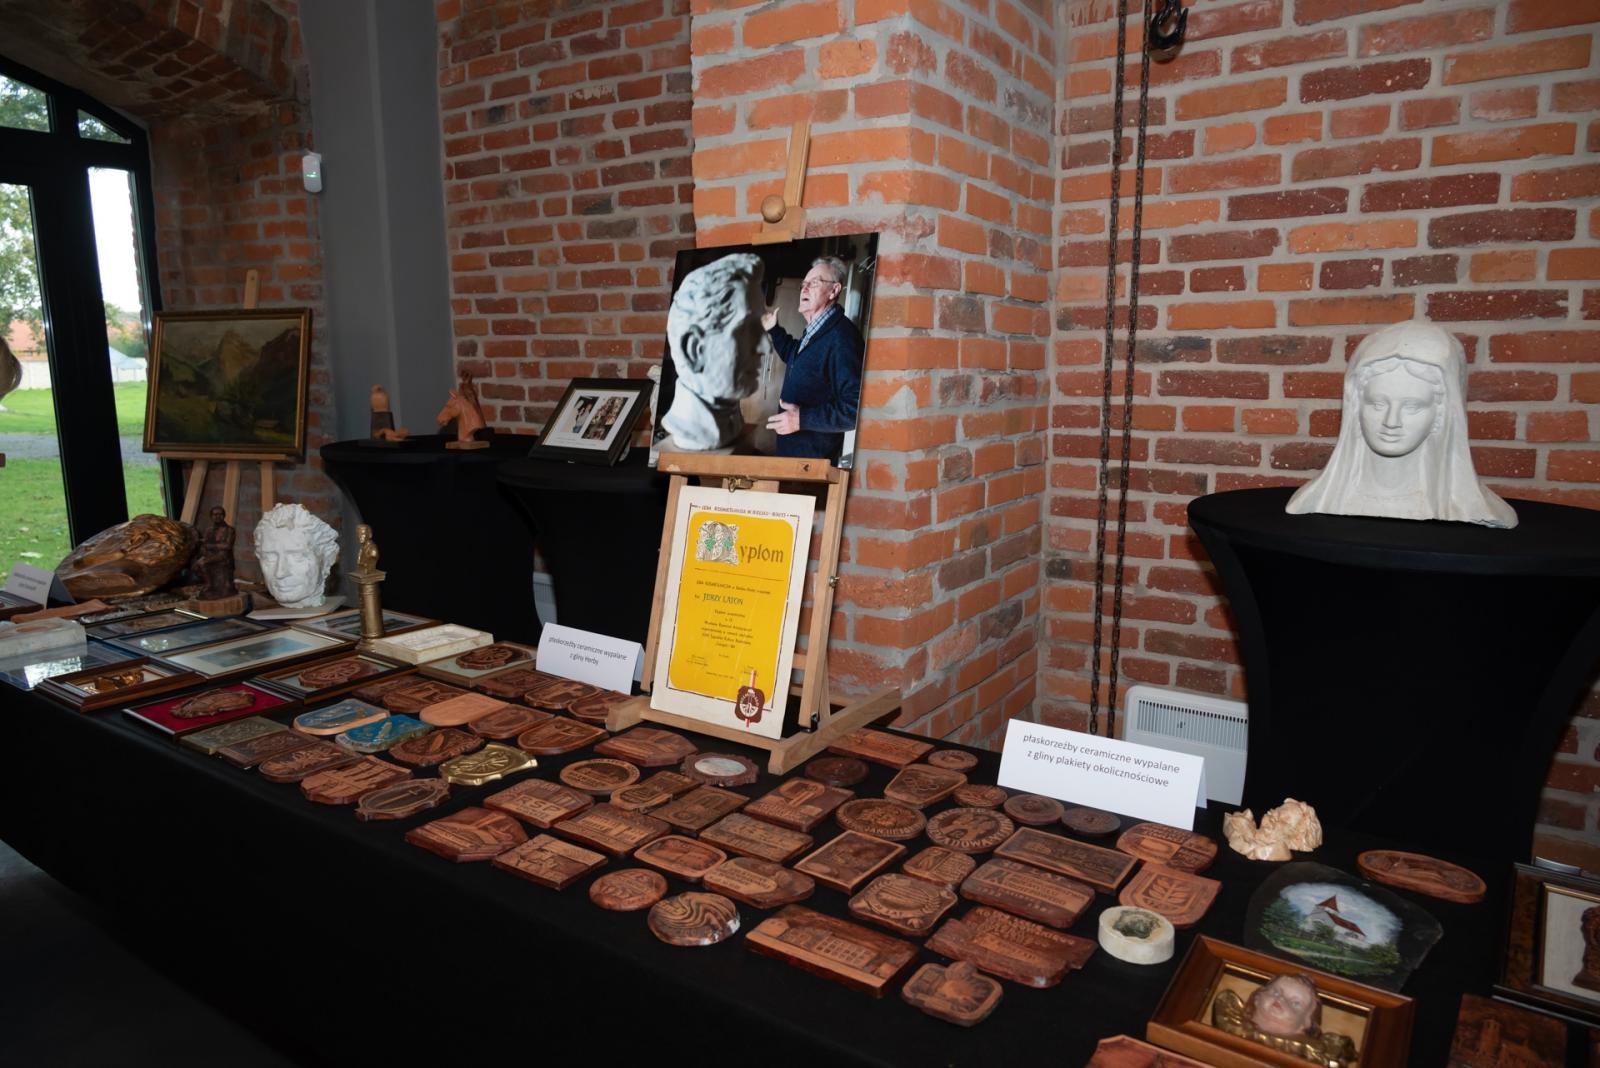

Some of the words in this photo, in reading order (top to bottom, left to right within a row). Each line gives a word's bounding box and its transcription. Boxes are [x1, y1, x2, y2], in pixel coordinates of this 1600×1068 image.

[1022, 733, 1078, 753] płaskorzeźby
[1079, 746, 1132, 764] ceramiczne
[1134, 757, 1180, 774] wypalane
[1027, 750, 1032, 758] z
[1033, 750, 1054, 764] gliny
[1055, 755, 1092, 772] plakiety
[1093, 763, 1169, 787] okolicznościowe
[515, 795, 562, 811] RSP
